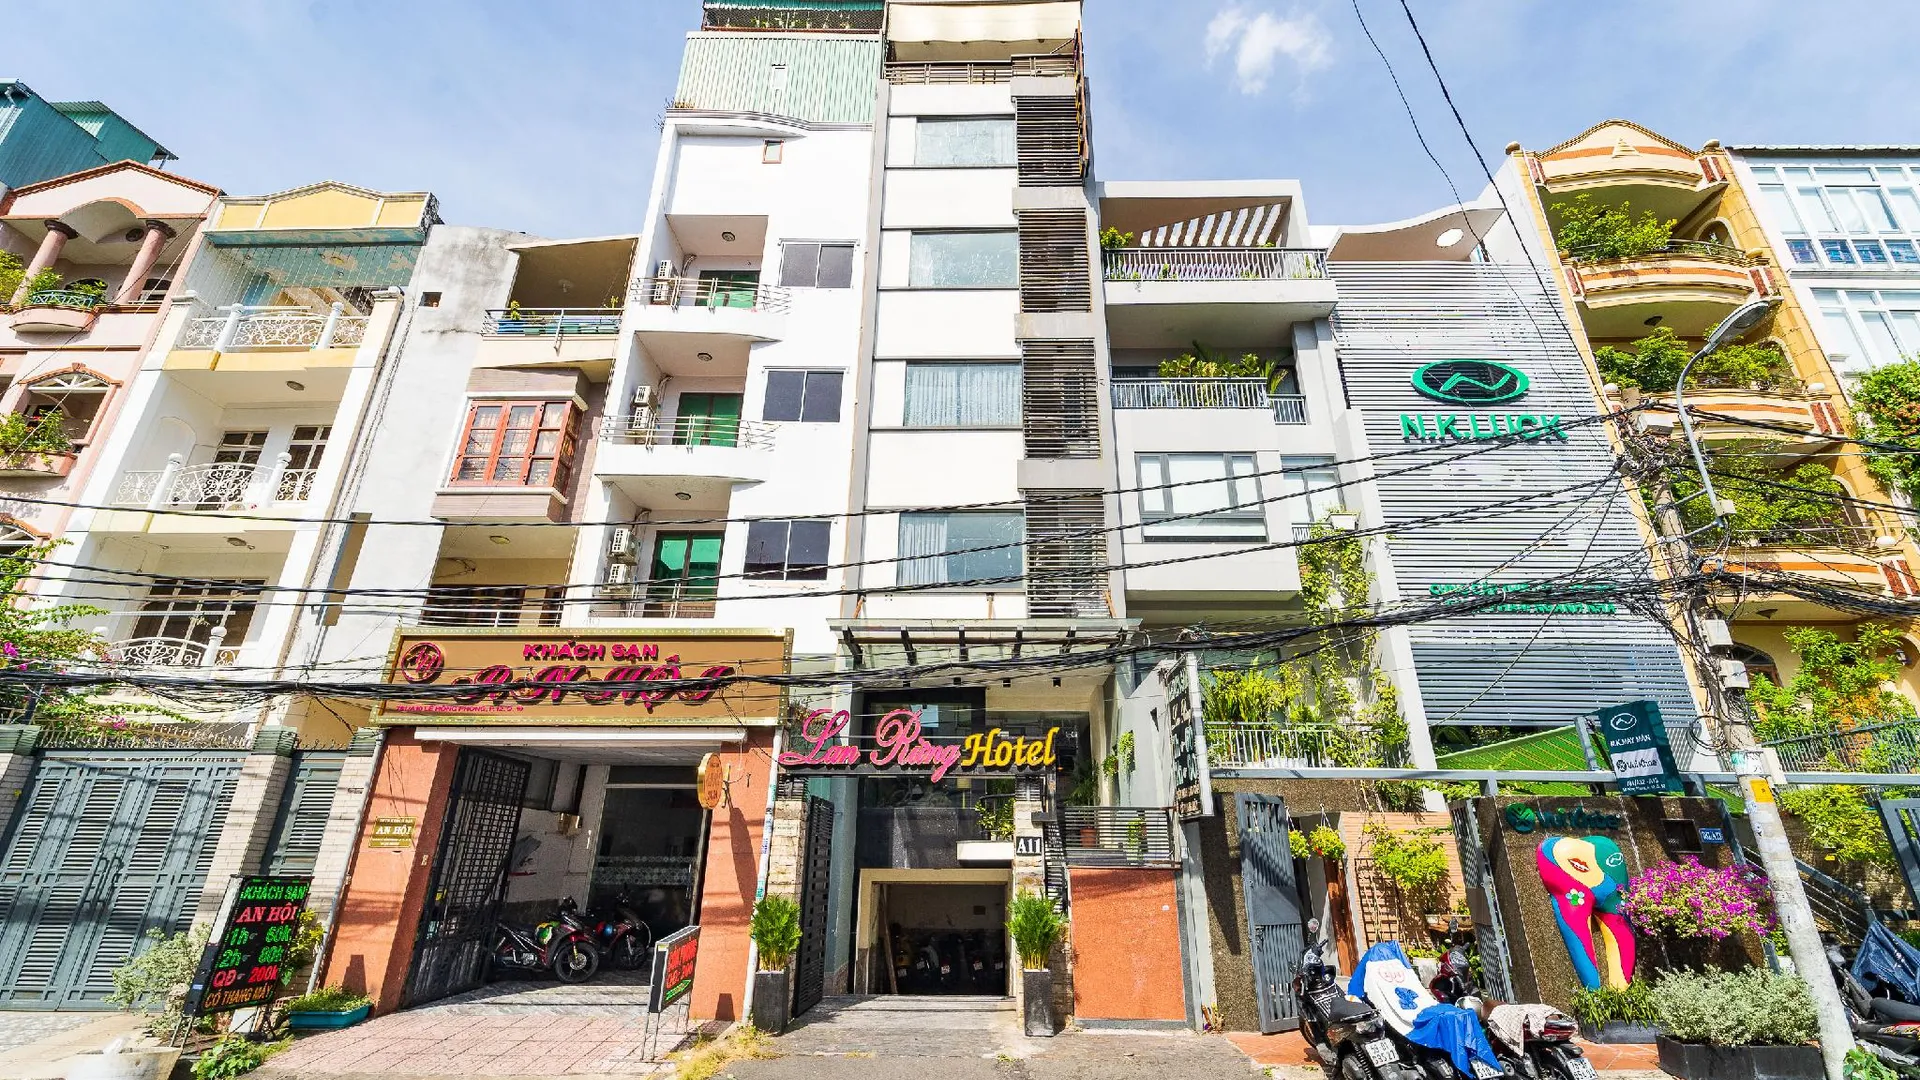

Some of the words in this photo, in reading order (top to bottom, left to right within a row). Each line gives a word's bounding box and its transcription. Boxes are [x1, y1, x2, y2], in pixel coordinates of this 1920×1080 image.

[1399, 413, 1569, 440] N.K.LUCK
[523, 640, 606, 660] KHÁCH
[611, 643, 659, 664] SẠN
[777, 708, 861, 766] Lan
[869, 708, 961, 783] Rừng
[960, 726, 1061, 767] Hotel
[376, 826, 391, 835] AN
[393, 824, 412, 836] HỘI
[1017, 836, 1041, 854] A11
[244, 882, 284, 901] KHÁCH
[284, 885, 307, 902] SẠN
[236, 906, 267, 923] AN
[266, 901, 299, 924] HỘI
[229, 927, 250, 946] 1h
[218, 948, 242, 968] 2h
[221, 987, 253, 1007] THANG
